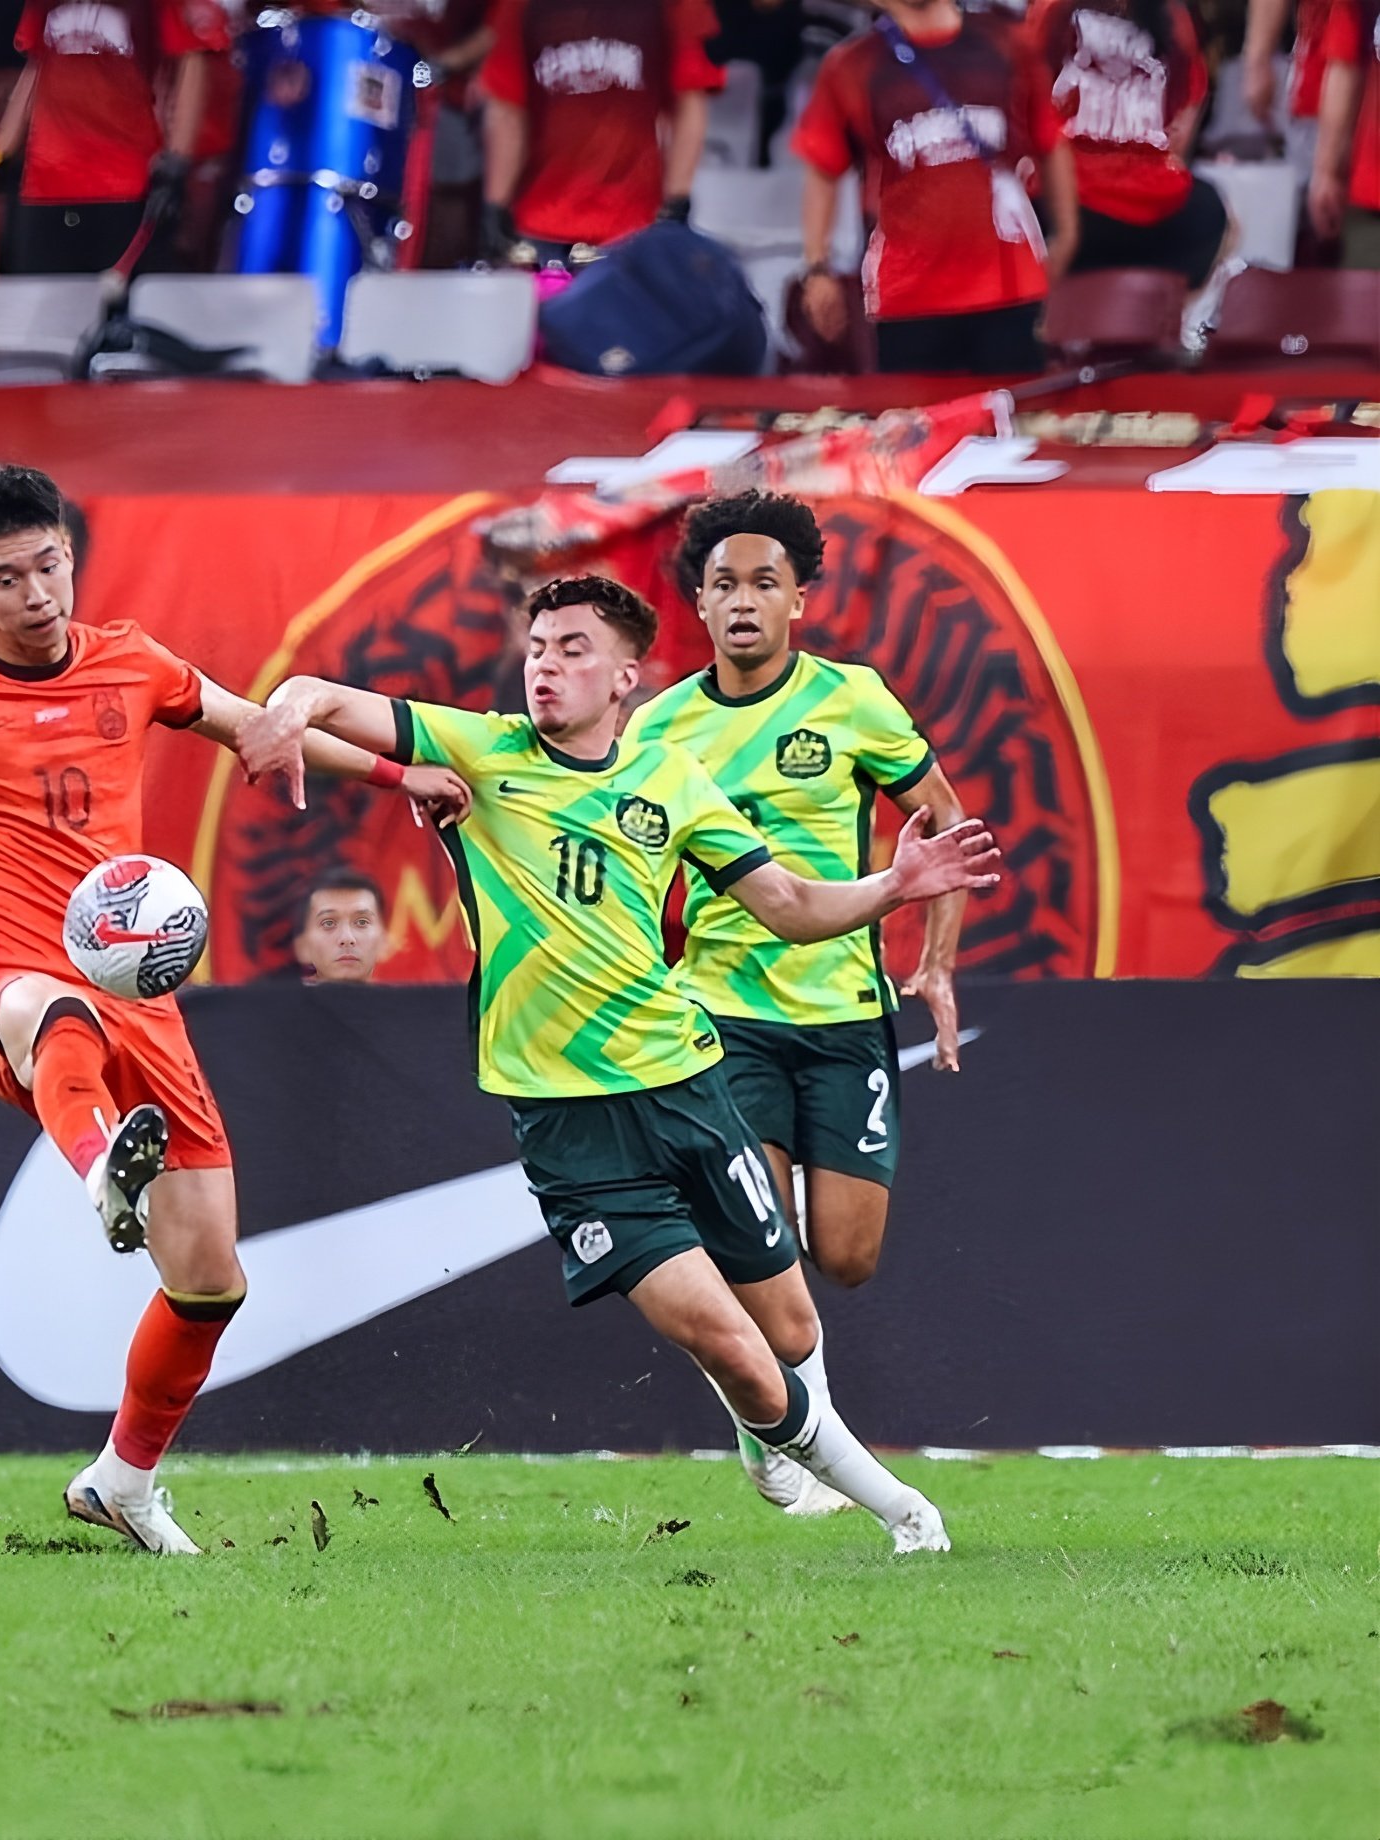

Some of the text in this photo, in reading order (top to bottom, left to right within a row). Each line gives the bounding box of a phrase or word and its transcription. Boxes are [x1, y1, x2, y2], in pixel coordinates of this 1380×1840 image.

[32, 765, 91, 831] 10
[549, 833, 608, 906] 10
[867, 1068, 890, 1136] 2
